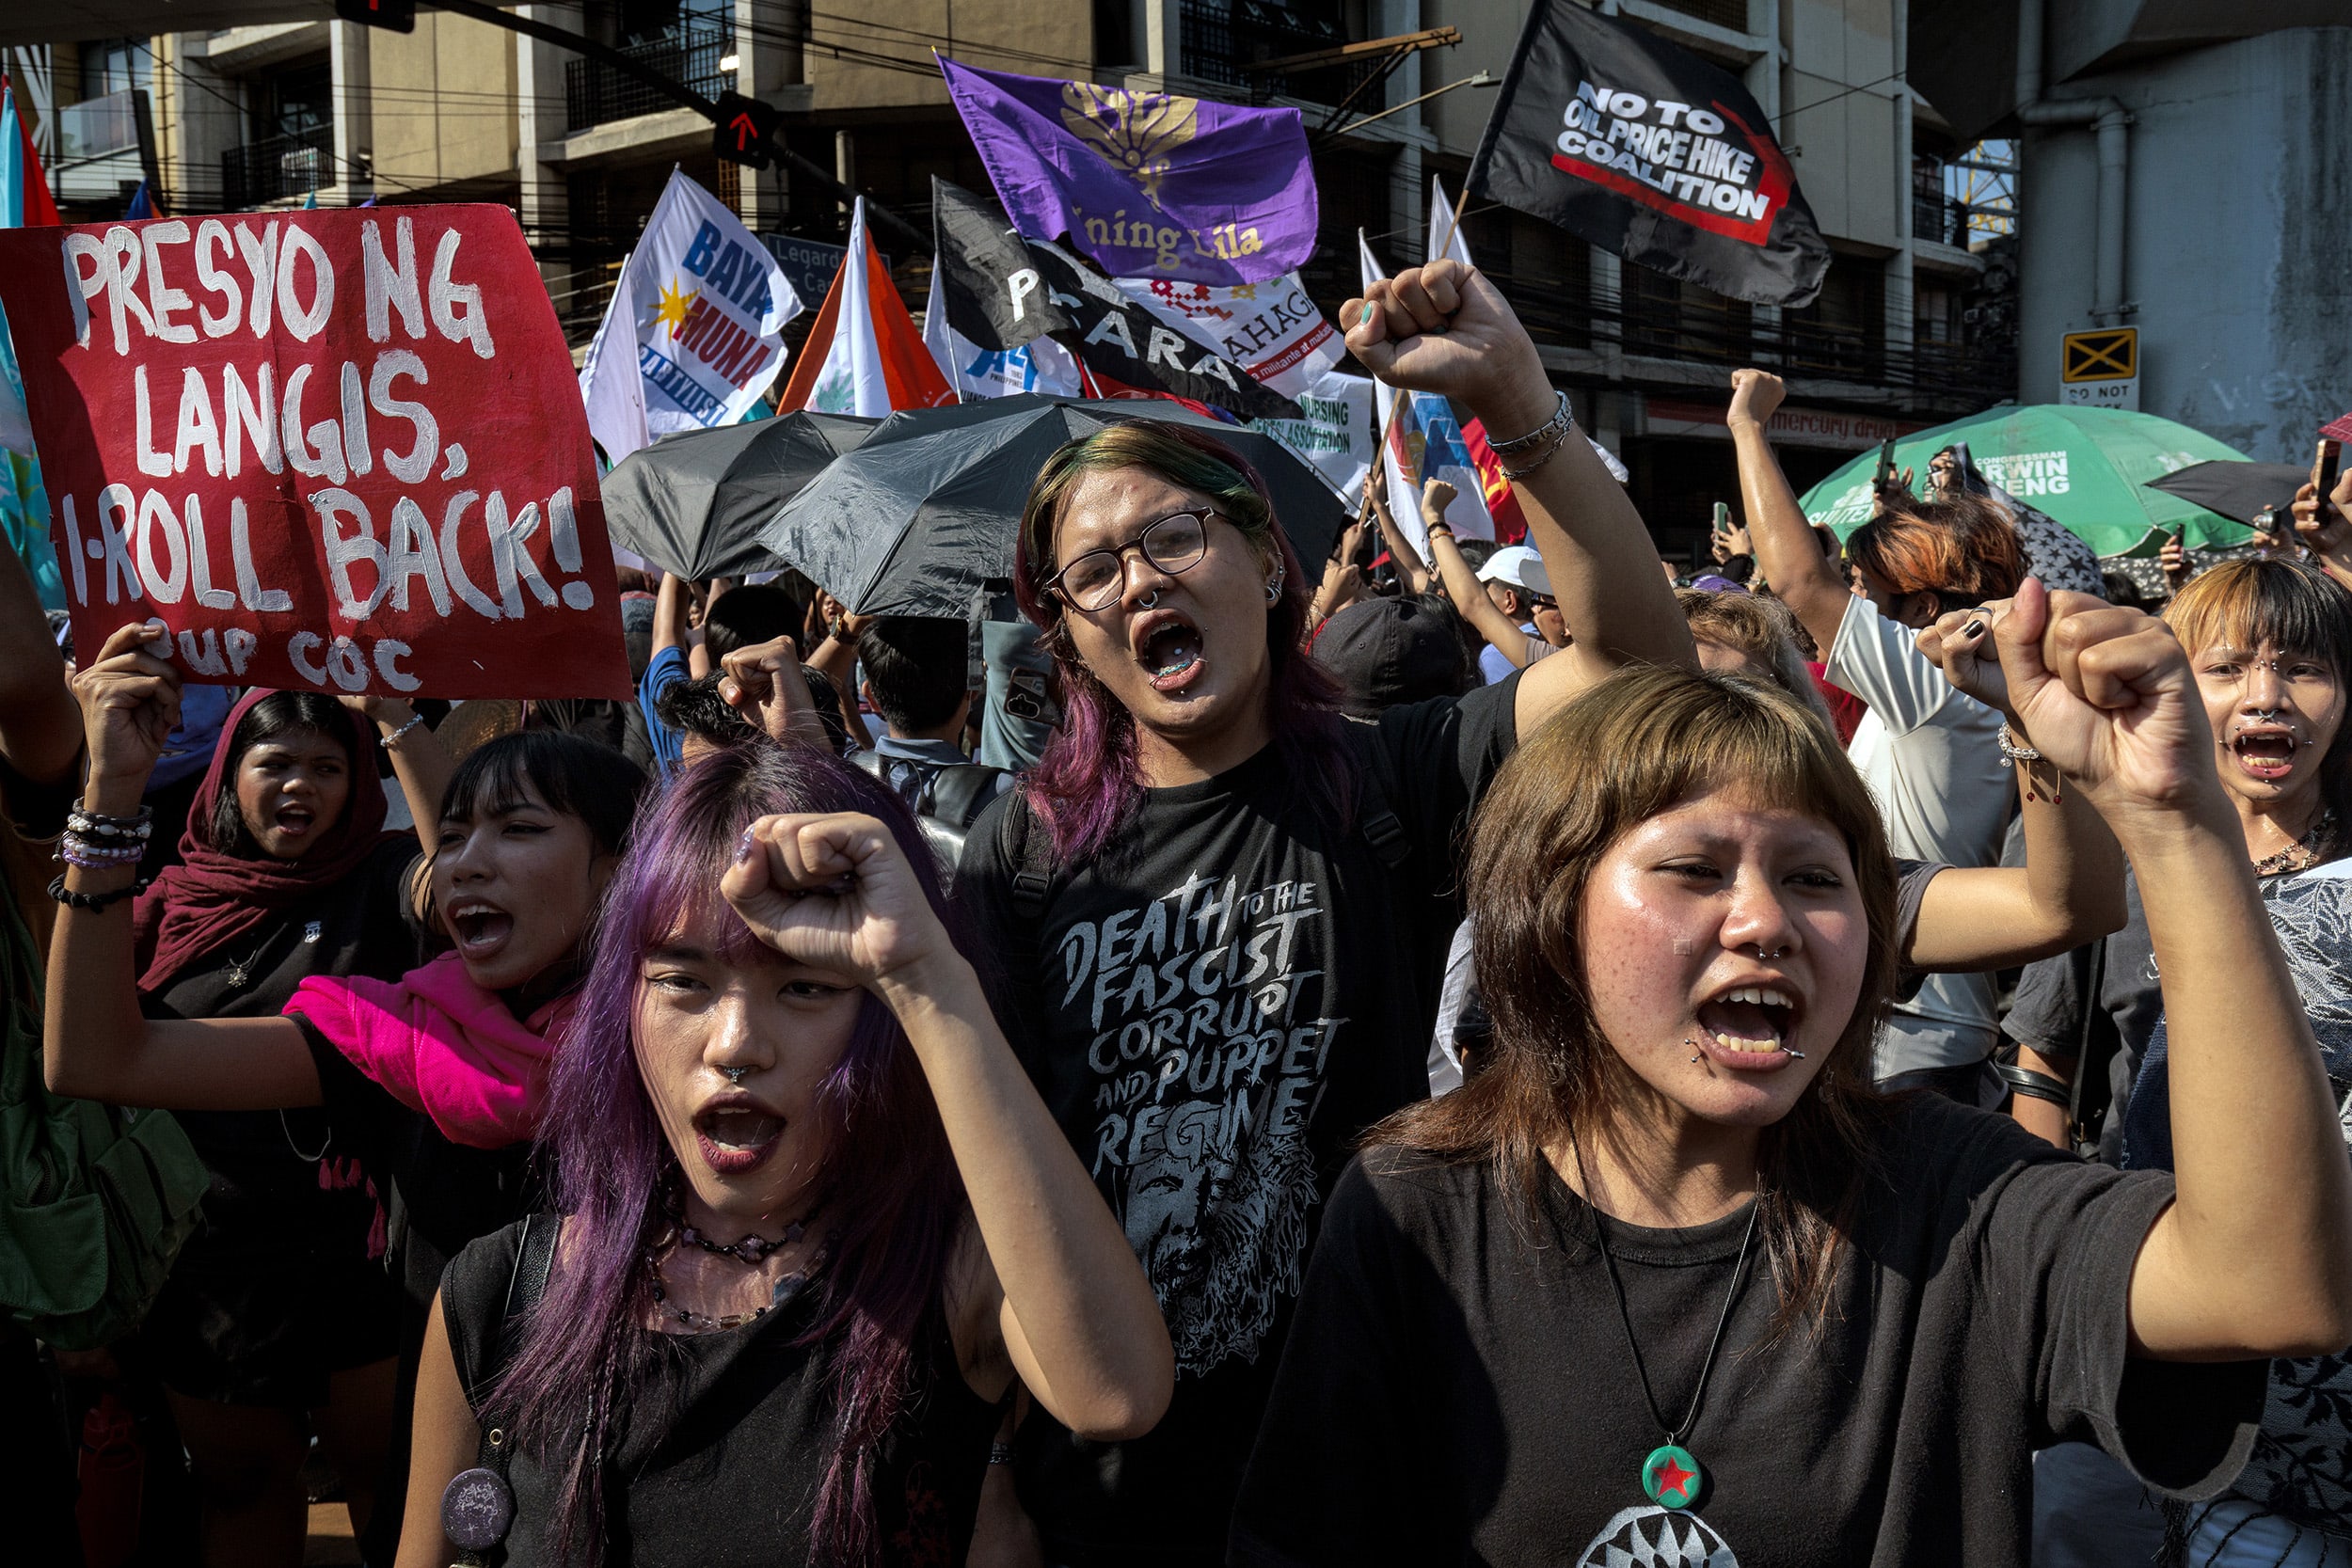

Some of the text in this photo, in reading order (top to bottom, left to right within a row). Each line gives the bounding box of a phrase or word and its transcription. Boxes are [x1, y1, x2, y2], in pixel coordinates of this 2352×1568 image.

[1577, 80, 1725, 135] NO TO
[1563, 99, 1755, 184] OIL PRICE HIKE
[1556, 130, 1770, 220] COALITION
[776, 240, 843, 270] Legard
[1073, 206, 1263, 271] ning Lila
[62, 216, 495, 359] PRESYO NG
[804, 272, 831, 293] Ca
[672, 295, 771, 391] MUNA
[1261, 350, 1302, 377] militante
[135, 349, 469, 485] LANGIS,
[1299, 394, 1349, 426] NURSING
[2098, 386, 2129, 398] NOT
[1287, 422, 1350, 454] ASSOCIATION
[1772, 411, 1849, 440] mercury
[1974, 450, 2067, 466] CONGRESSMAN
[1975, 458, 2069, 481] RWIN
[309, 485, 595, 622] BACK!
[1057, 869, 1317, 1011] DEATH TO THE
[1091, 910, 1323, 1033] FASCIST
[1089, 969, 1326, 1074] CORRUPT
[1094, 1017, 1351, 1116] AND PUPPET
